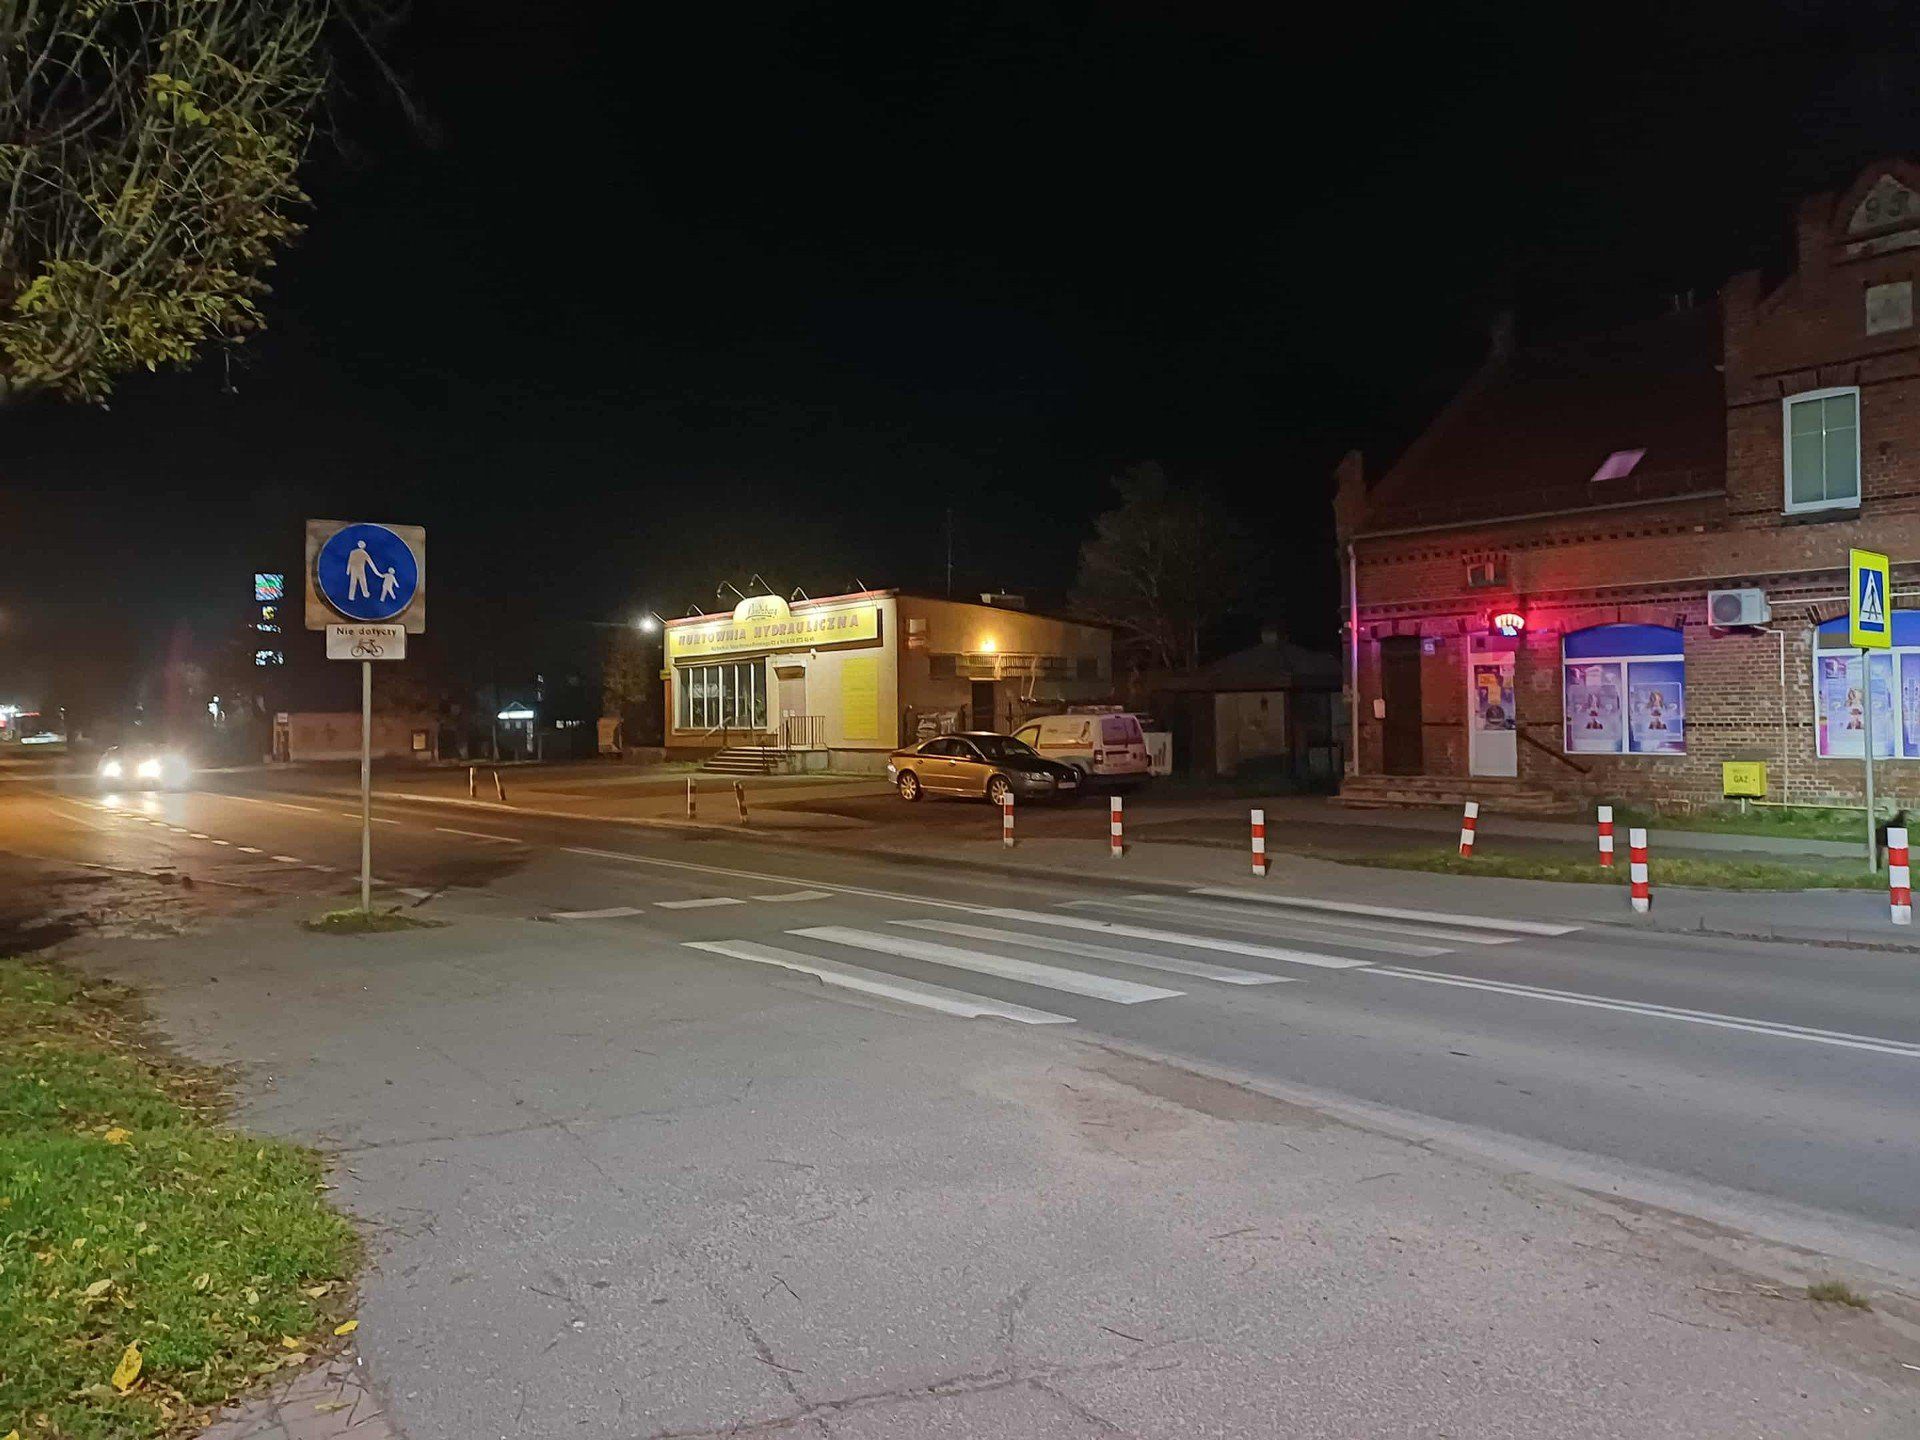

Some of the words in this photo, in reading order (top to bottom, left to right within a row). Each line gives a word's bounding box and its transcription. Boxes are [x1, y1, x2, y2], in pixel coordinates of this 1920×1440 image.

[336, 627, 354, 635] Nie
[359, 626, 397, 637] dotyczy
[678, 628, 746, 646] HURTOWNIA
[753, 614, 859, 638] HYDRAULICZNA
[1733, 775, 1749, 783] GAZ
